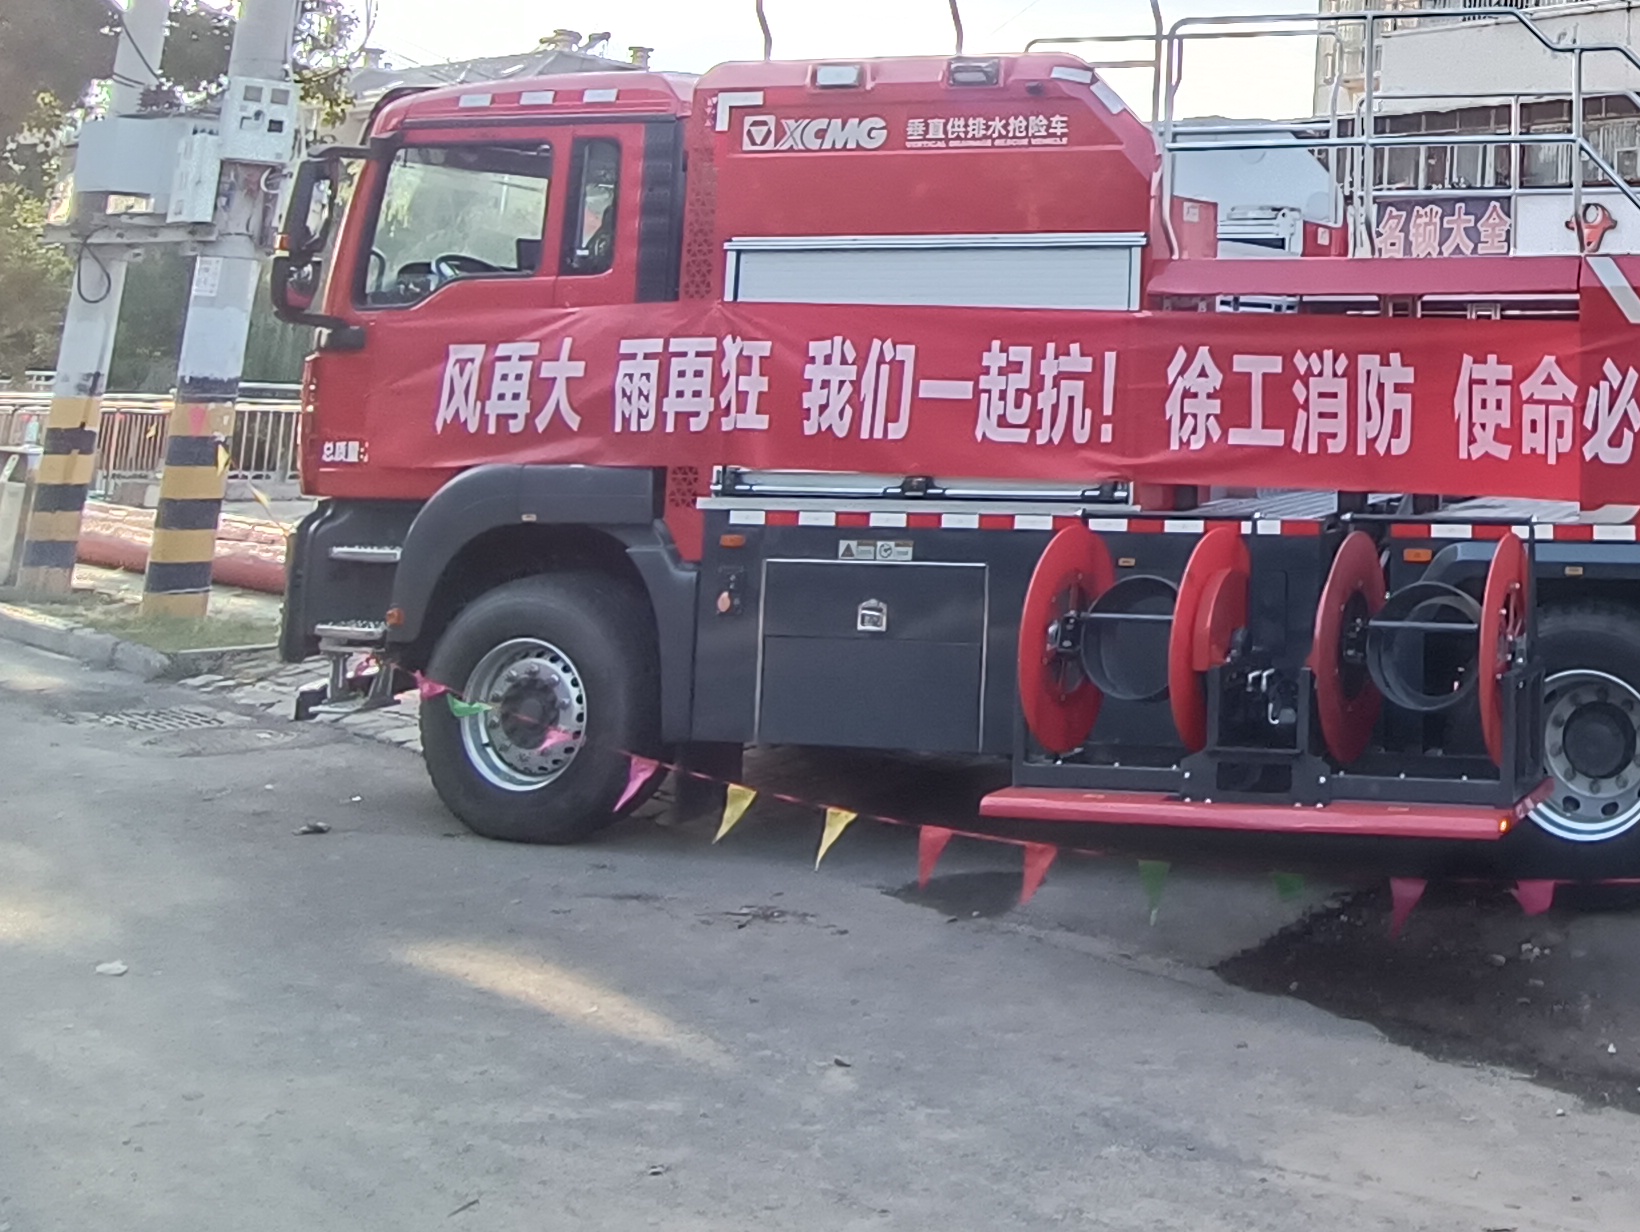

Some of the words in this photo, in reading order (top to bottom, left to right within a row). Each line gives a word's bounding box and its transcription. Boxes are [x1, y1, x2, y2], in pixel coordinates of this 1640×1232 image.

[774, 117, 888, 150] XCMG
[906, 114, 1069, 139] 垂直供排水抢险车
[435, 337, 586, 435] 风再大
[613, 335, 772, 434] 雨再狂
[802, 335, 1117, 445] 我们一起抗！
[1165, 345, 1415, 457] 徐工消防
[321, 441, 369, 462] 总质量:
